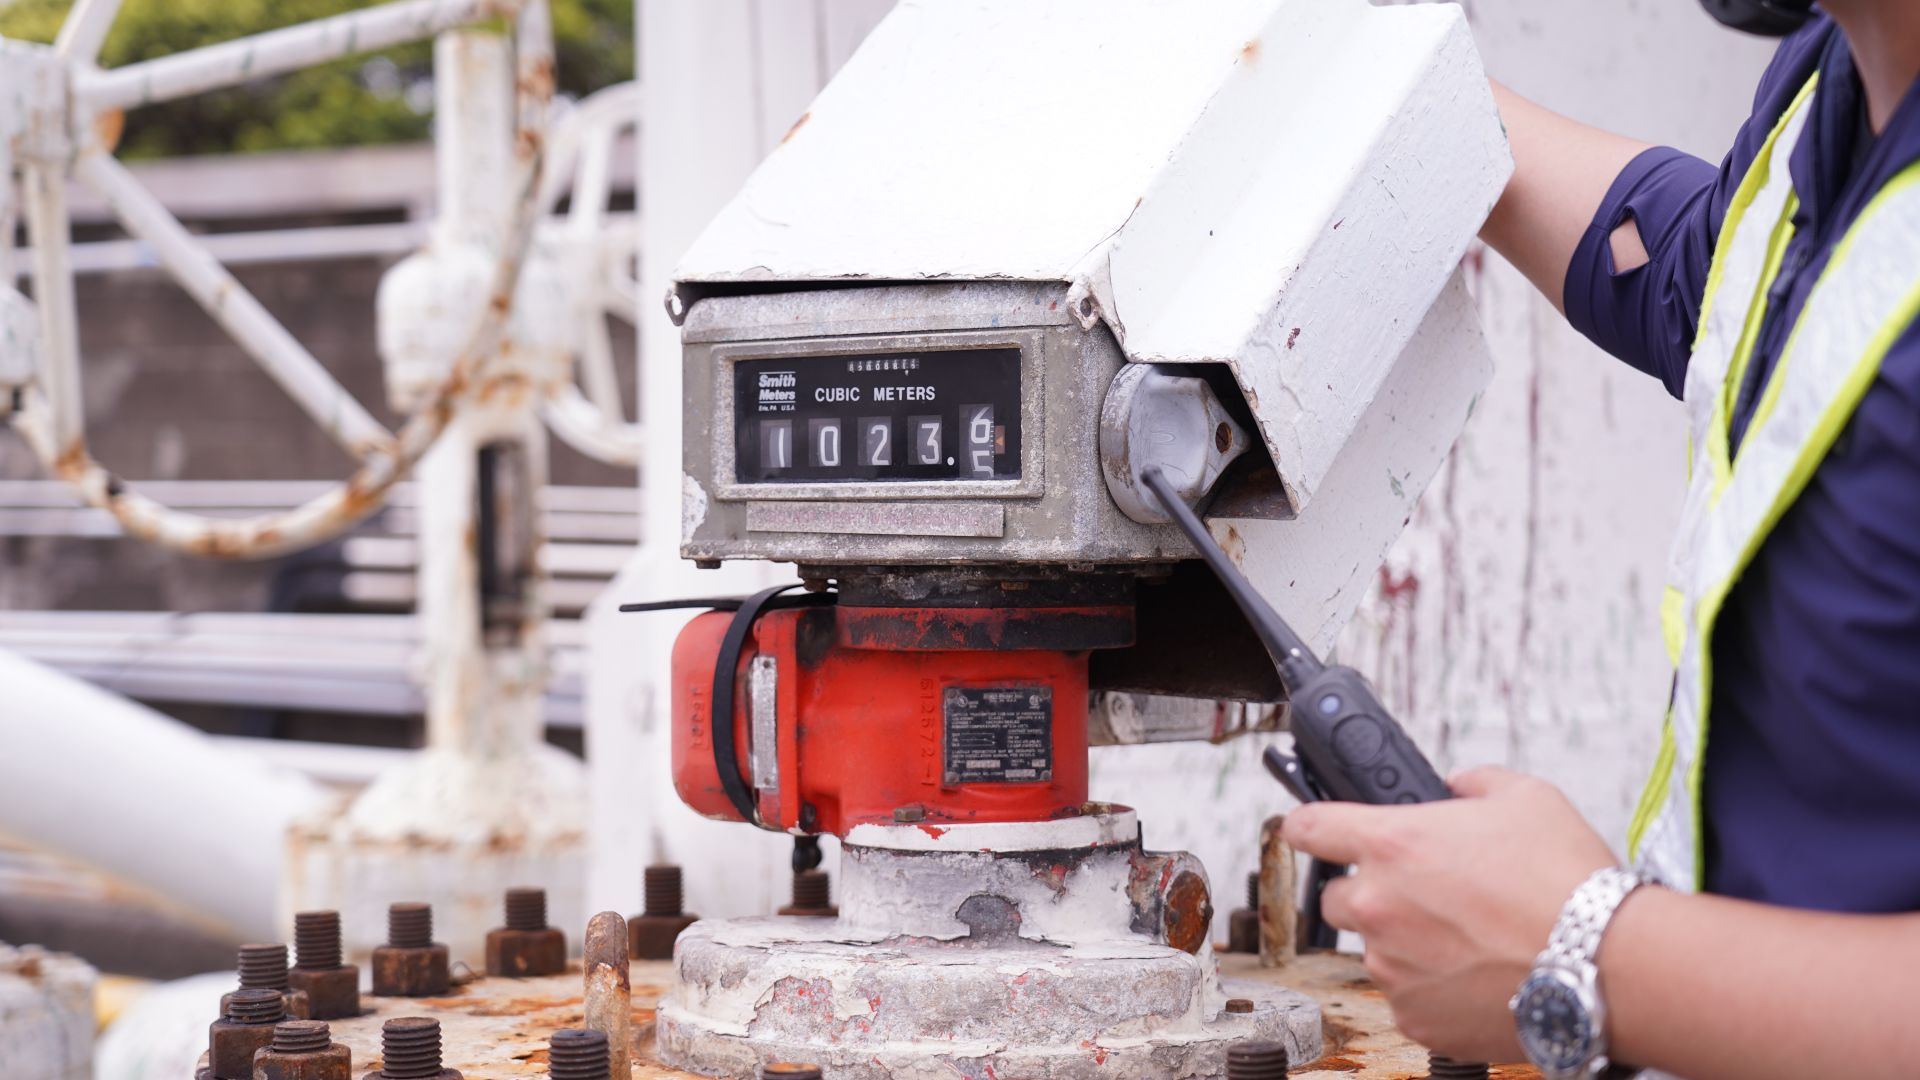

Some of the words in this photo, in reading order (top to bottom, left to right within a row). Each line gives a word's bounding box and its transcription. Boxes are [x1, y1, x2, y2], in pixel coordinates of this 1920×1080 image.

[759, 375, 796, 388] Smith
[759, 389, 796, 400] Meters
[814, 387, 860, 402] CUBIC
[873, 386, 936, 401] METERS
